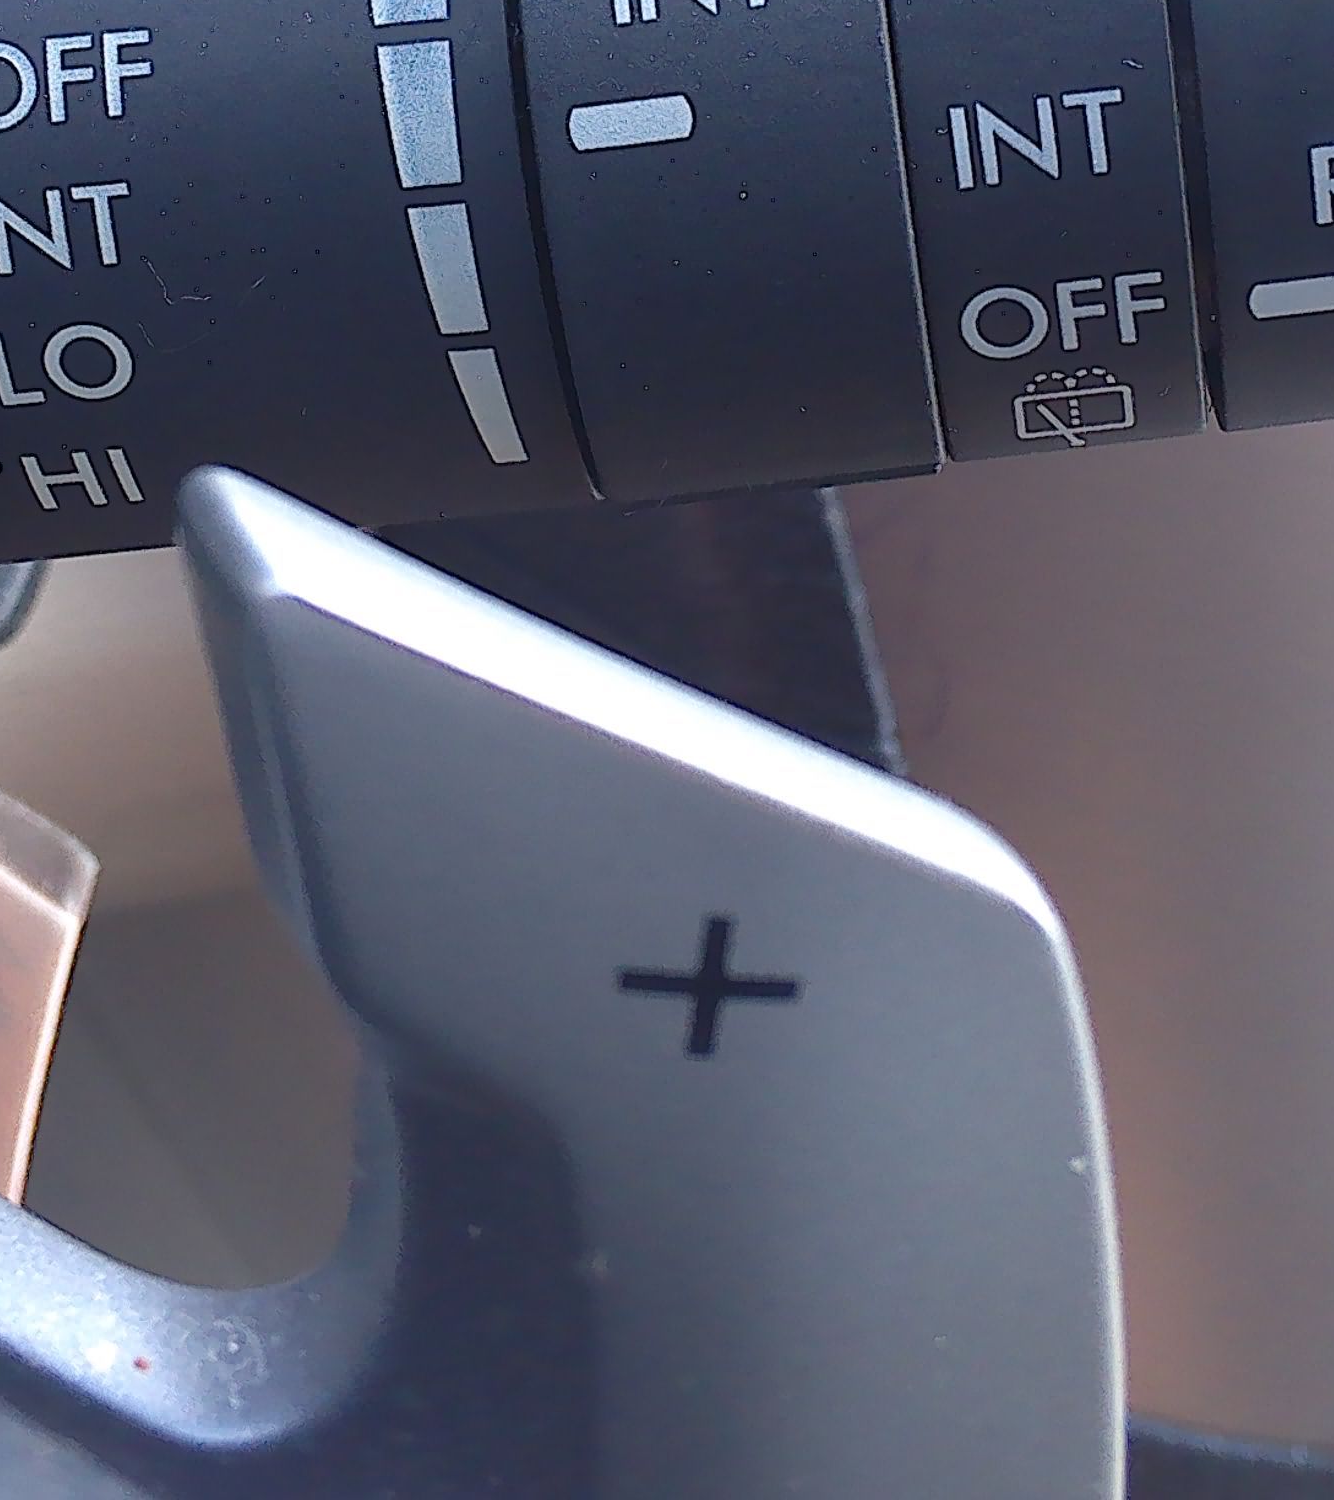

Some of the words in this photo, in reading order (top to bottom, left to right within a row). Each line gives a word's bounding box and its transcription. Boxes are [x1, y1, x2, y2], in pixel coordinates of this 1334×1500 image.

[947, 87, 1124, 191] INT
[959, 270, 1167, 361] OFF
[19, 446, 146, 511] HI
